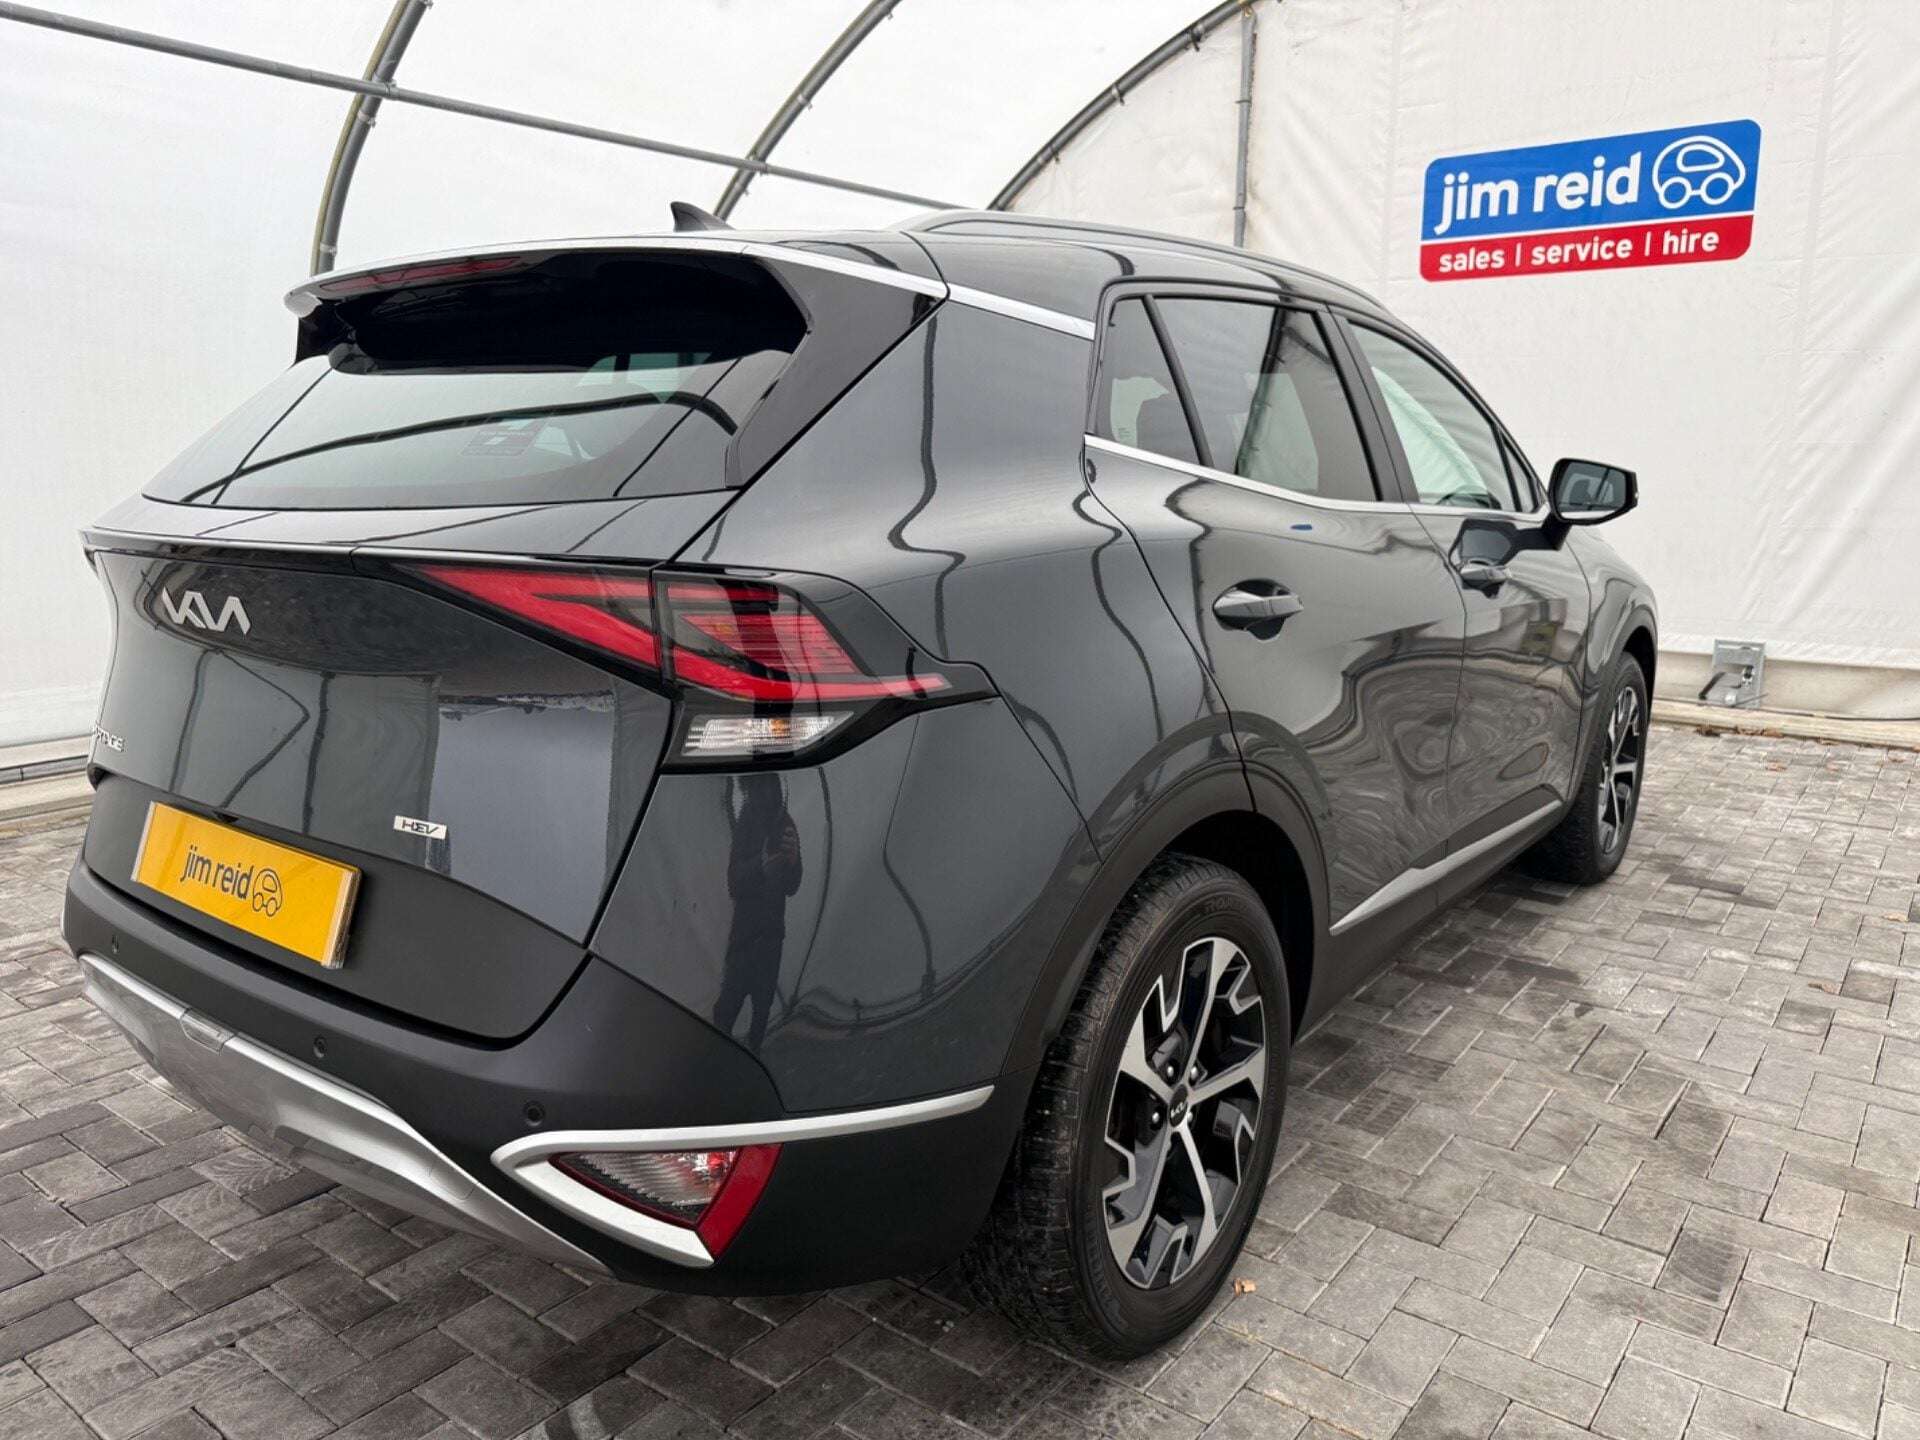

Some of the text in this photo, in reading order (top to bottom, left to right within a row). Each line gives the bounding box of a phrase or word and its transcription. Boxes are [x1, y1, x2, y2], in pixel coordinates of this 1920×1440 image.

[1433, 151, 1642, 236] jim reid
[1438, 228, 1719, 273] sales service hire
[162, 586, 251, 636] KIA
[401, 819, 440, 835] HEV
[180, 845, 254, 900] jim reid
